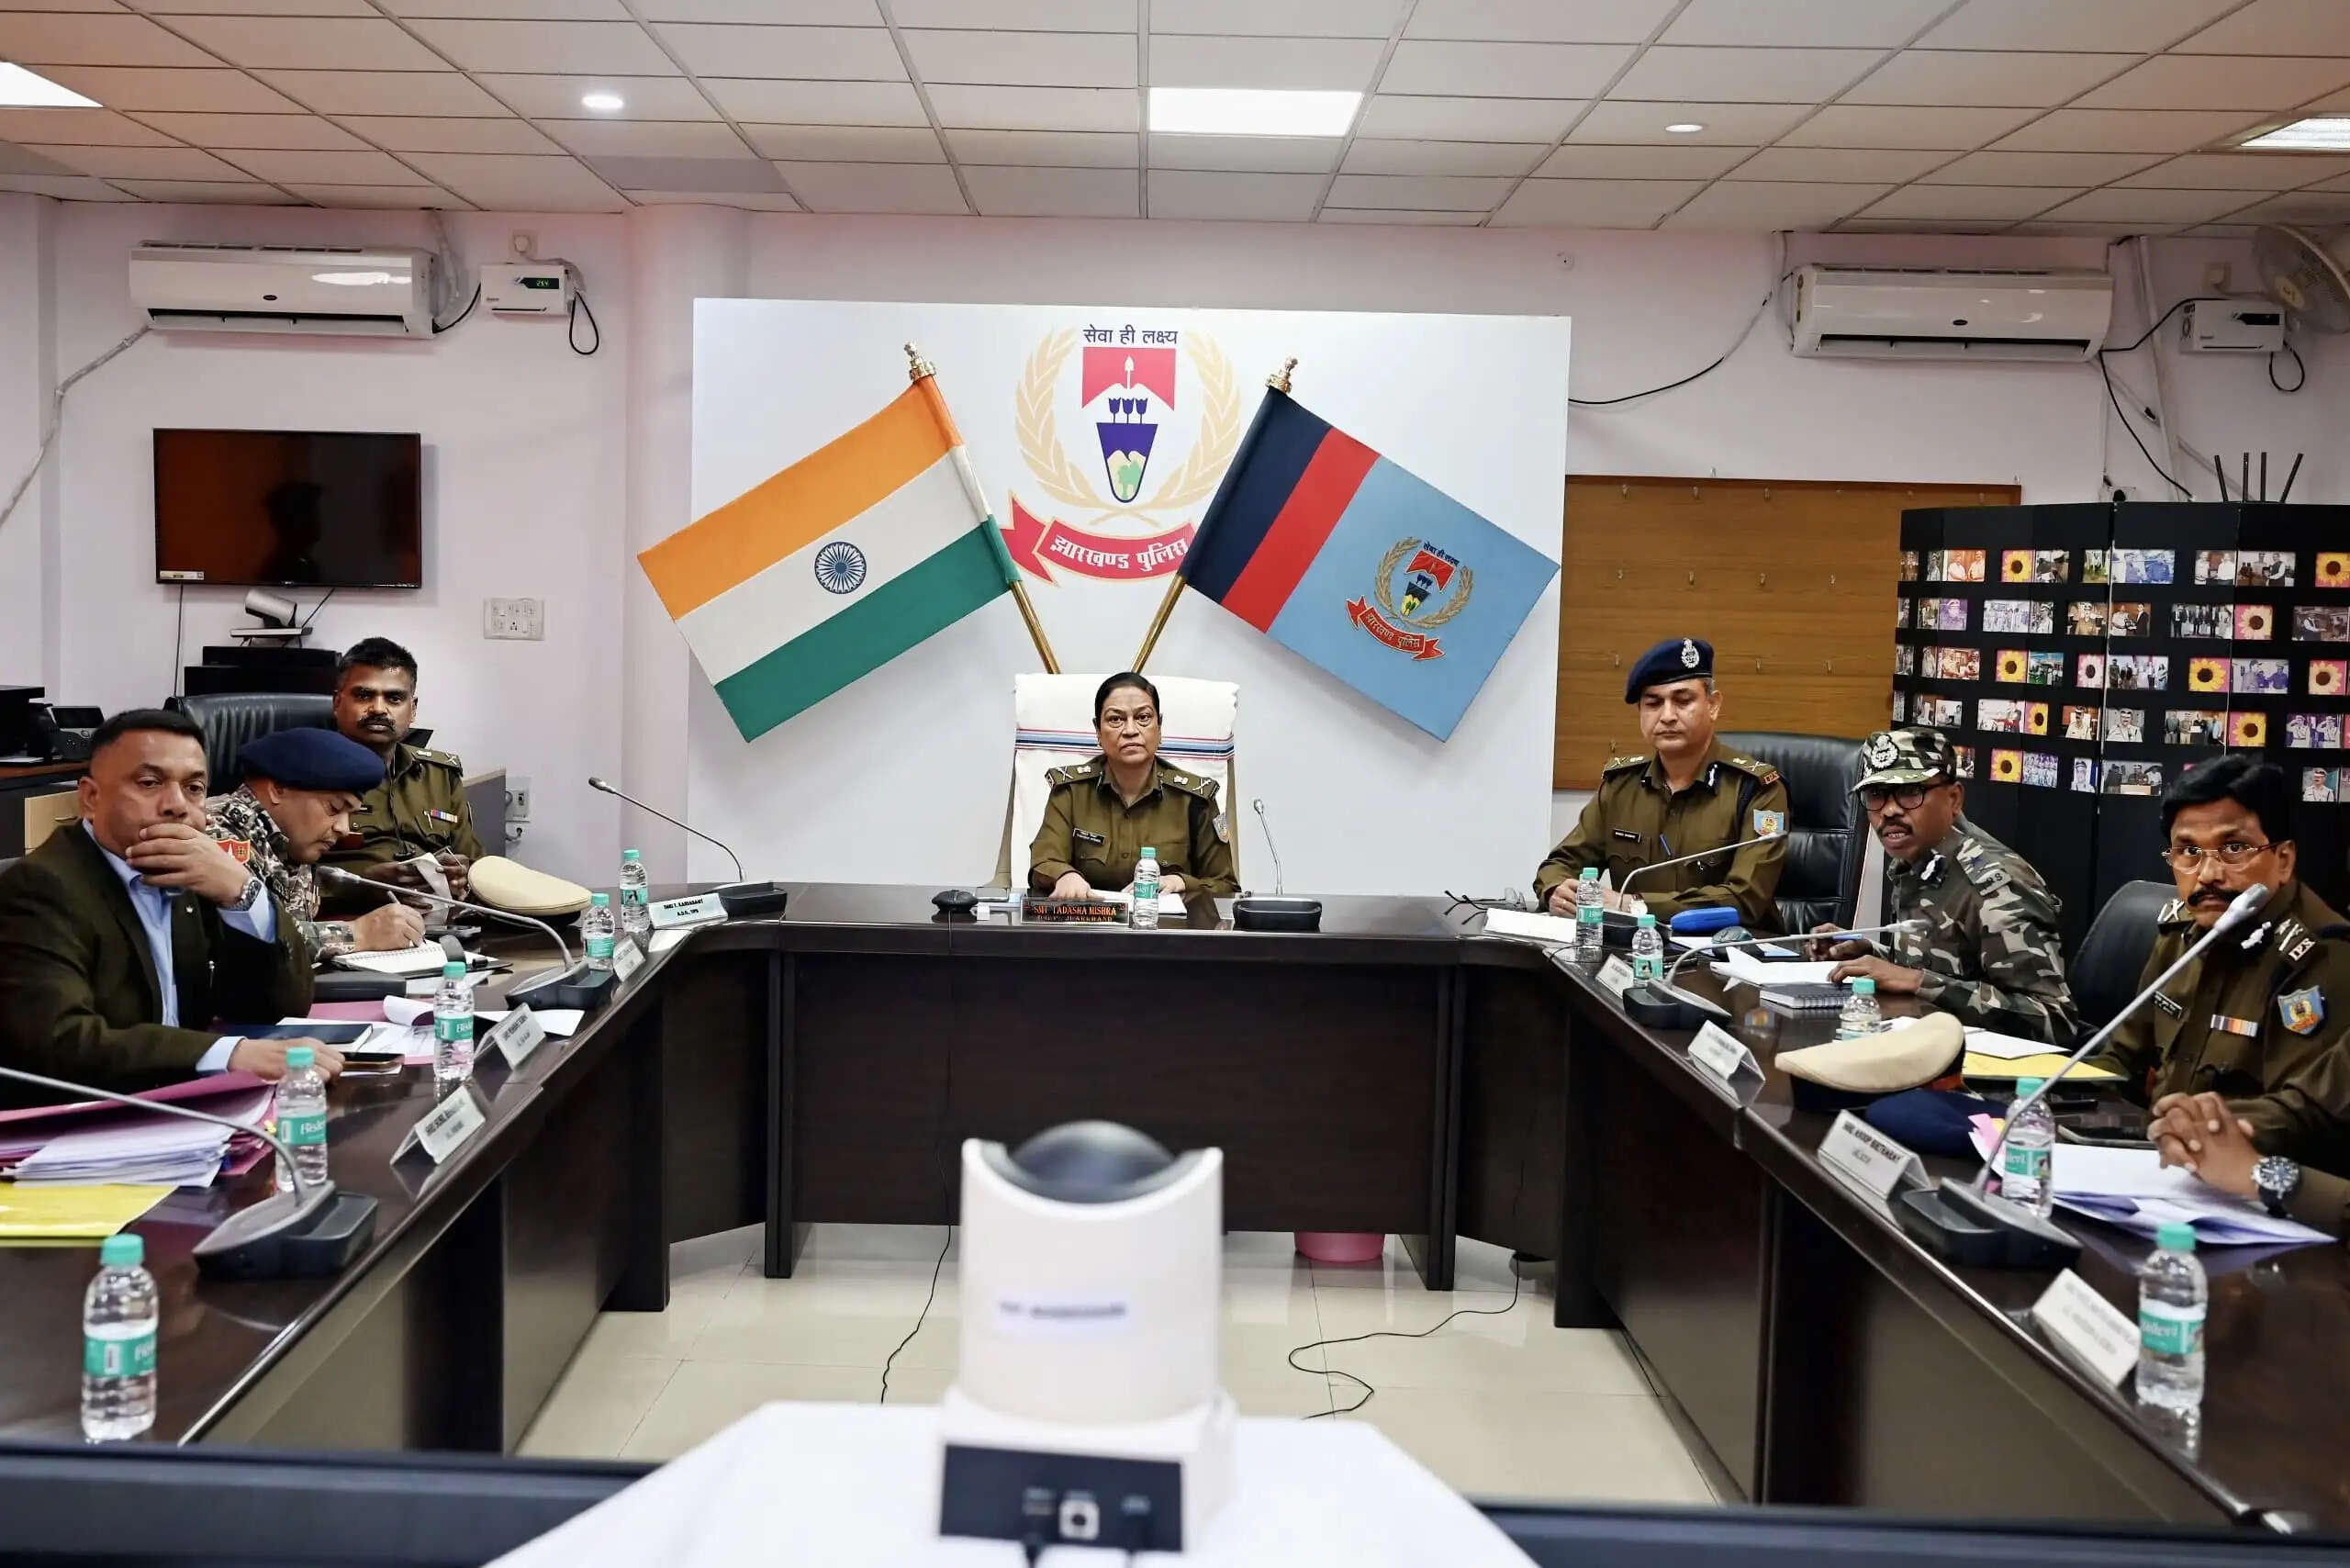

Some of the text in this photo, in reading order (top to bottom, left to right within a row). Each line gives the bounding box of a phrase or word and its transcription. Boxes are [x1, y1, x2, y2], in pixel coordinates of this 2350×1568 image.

[1082, 323, 1179, 345] सेवा ही लक्ष्य
[1050, 535, 1130, 569] झारखण्ड
[1089, 906, 1117, 916] MISHRA
[2288, 937, 2316, 961] IPS
